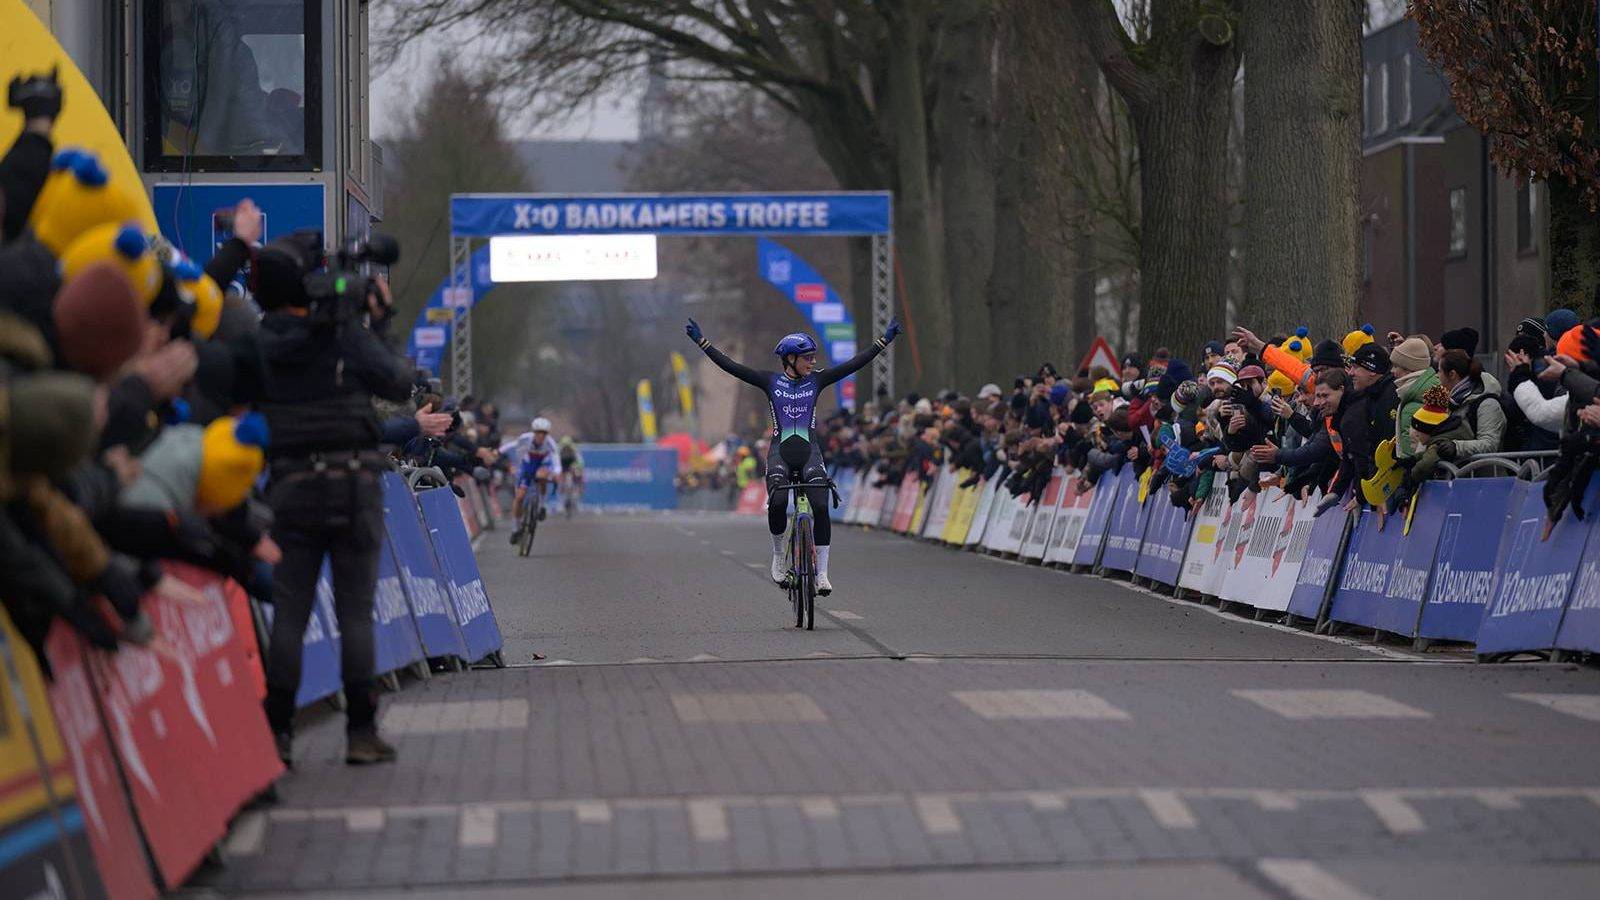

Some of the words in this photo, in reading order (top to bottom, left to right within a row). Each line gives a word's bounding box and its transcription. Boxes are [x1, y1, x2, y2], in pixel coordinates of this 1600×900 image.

[566, 202, 726, 227] BADKAMERS
[734, 201, 829, 226] TROFEE
[782, 390, 814, 400] baloise
[1445, 569, 1493, 604] BADKAMERS
[1510, 571, 1571, 613] BADKAMERS
